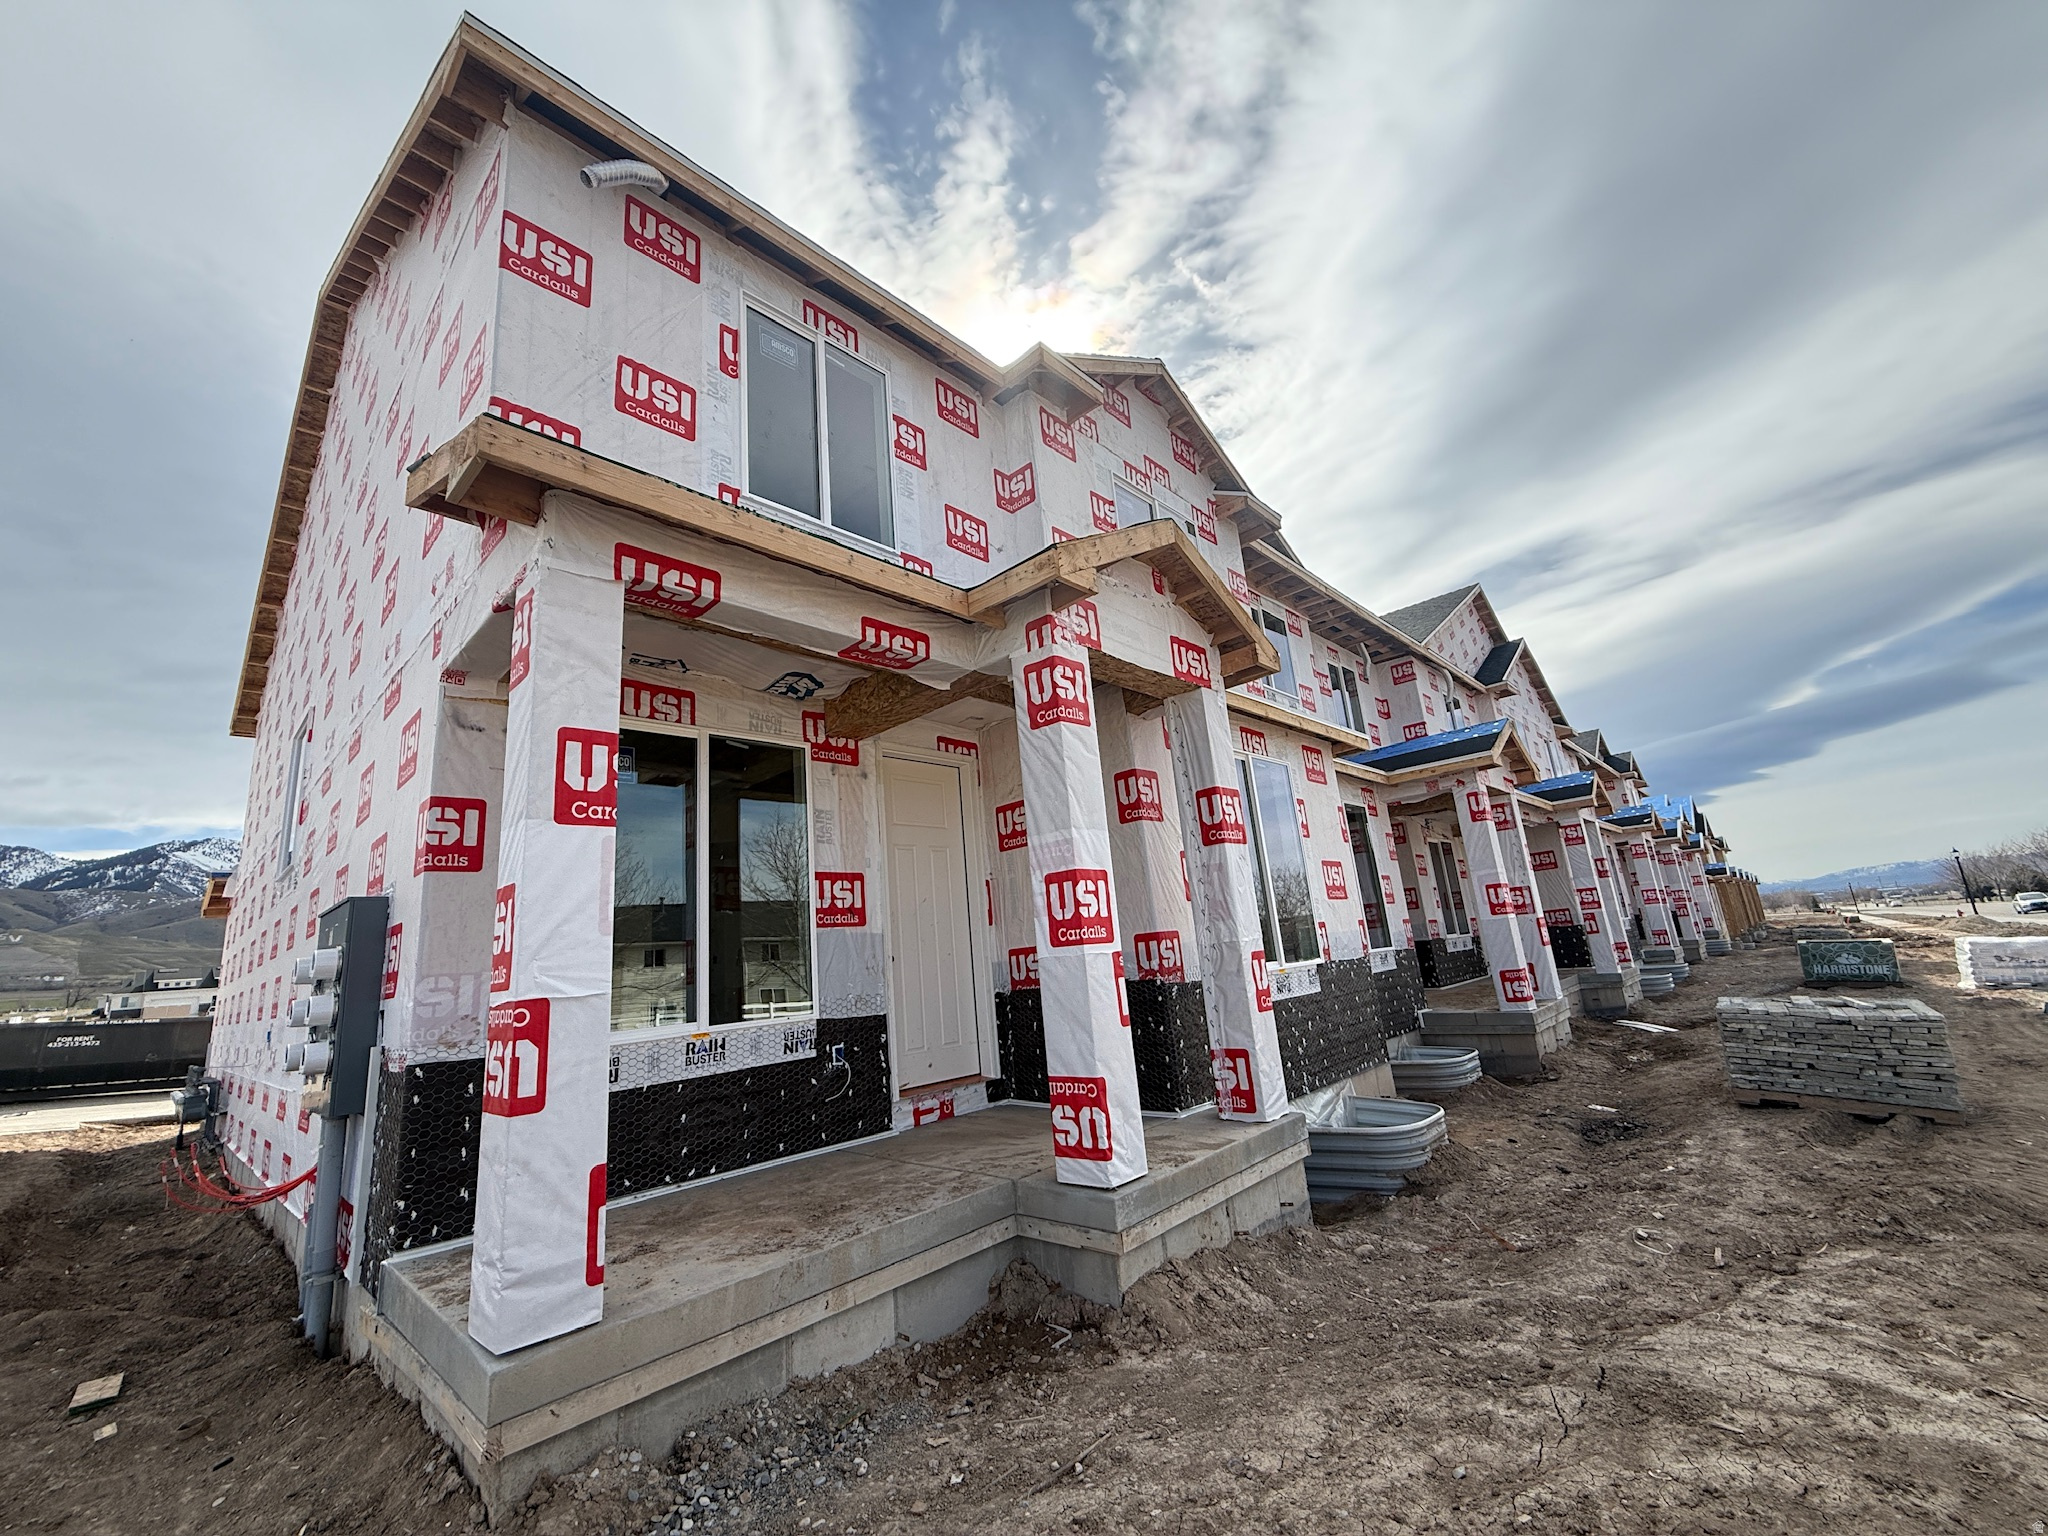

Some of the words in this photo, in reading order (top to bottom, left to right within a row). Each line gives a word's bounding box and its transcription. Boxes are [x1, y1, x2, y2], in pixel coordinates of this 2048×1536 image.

[629, 202, 697, 265] USI
[502, 218, 588, 287] USI
[634, 238, 691, 277] Cardalls
[508, 257, 579, 300] Cardalls
[621, 362, 692, 422] USI
[938, 384, 976, 425] USI
[1103, 386, 1129, 417] USI
[625, 401, 686, 435] Cardalls
[942, 410, 974, 434] Cardalls
[1041, 411, 1074, 448] USI
[894, 421, 923, 457] SI
[1172, 434, 1196, 464] USI
[895, 446, 921, 466] rdalls
[996, 468, 1033, 499] USI
[1145, 459, 1171, 490] USI
[1001, 495, 1030, 511] Cardalls
[1091, 495, 1115, 525] US
[947, 510, 986, 548] USI
[951, 538, 984, 558] Cardalls
[620, 555, 715, 608] USI
[1229, 571, 1247, 595] USI
[625, 592, 690, 614] ardalls
[1287, 611, 1301, 631] USI
[858, 625, 926, 663] USI
[1172, 642, 1209, 680] USI
[1027, 664, 1086, 706] USI
[1300, 688, 1315, 705] USI
[623, 686, 691, 725] USI
[1037, 704, 1085, 722] Cardalls
[401, 718, 420, 766] USI
[812, 748, 852, 763] Cardalls
[1304, 750, 1323, 773] USI
[1117, 775, 1159, 806] USI
[997, 808, 1027, 835] US
[1125, 807, 1159, 819] Cardalls
[1200, 793, 1244, 825] USI
[1492, 804, 1513, 822] SI
[416, 802, 479, 849] USI
[1209, 828, 1243, 840] Cardalls
[1003, 834, 1027, 848] Carda
[369, 840, 386, 880] USI
[1532, 853, 1555, 866] USI
[1323, 866, 1345, 887] USI
[815, 879, 862, 909] USI
[1048, 878, 1109, 921] USI
[1405, 890, 1417, 903] SI
[1511, 889, 1531, 906] SI
[493, 898, 513, 955] SI
[816, 913, 859, 925] Cardalls
[1546, 910, 1571, 923] USI
[1058, 925, 1107, 942] Cardalls
[384, 933, 402, 977] SI
[1011, 952, 1038, 982] US
[1138, 938, 1182, 970] USI
[1813, 963, 1891, 976] HARRISTONE
[416, 975, 475, 1019] SI
[488, 1007, 531, 1028] Cardalls
[74, 1034, 95, 1042] RENT
[686, 1037, 726, 1055] RAIN
[783, 1027, 816, 1040] BUSTER
[783, 1041, 816, 1055] RAIN
[685, 1051, 726, 1067] BUSTER
[1214, 1056, 1250, 1091] SI
[1050, 1082, 1097, 1097] Cardall
[1051, 1104, 1109, 1151] US
